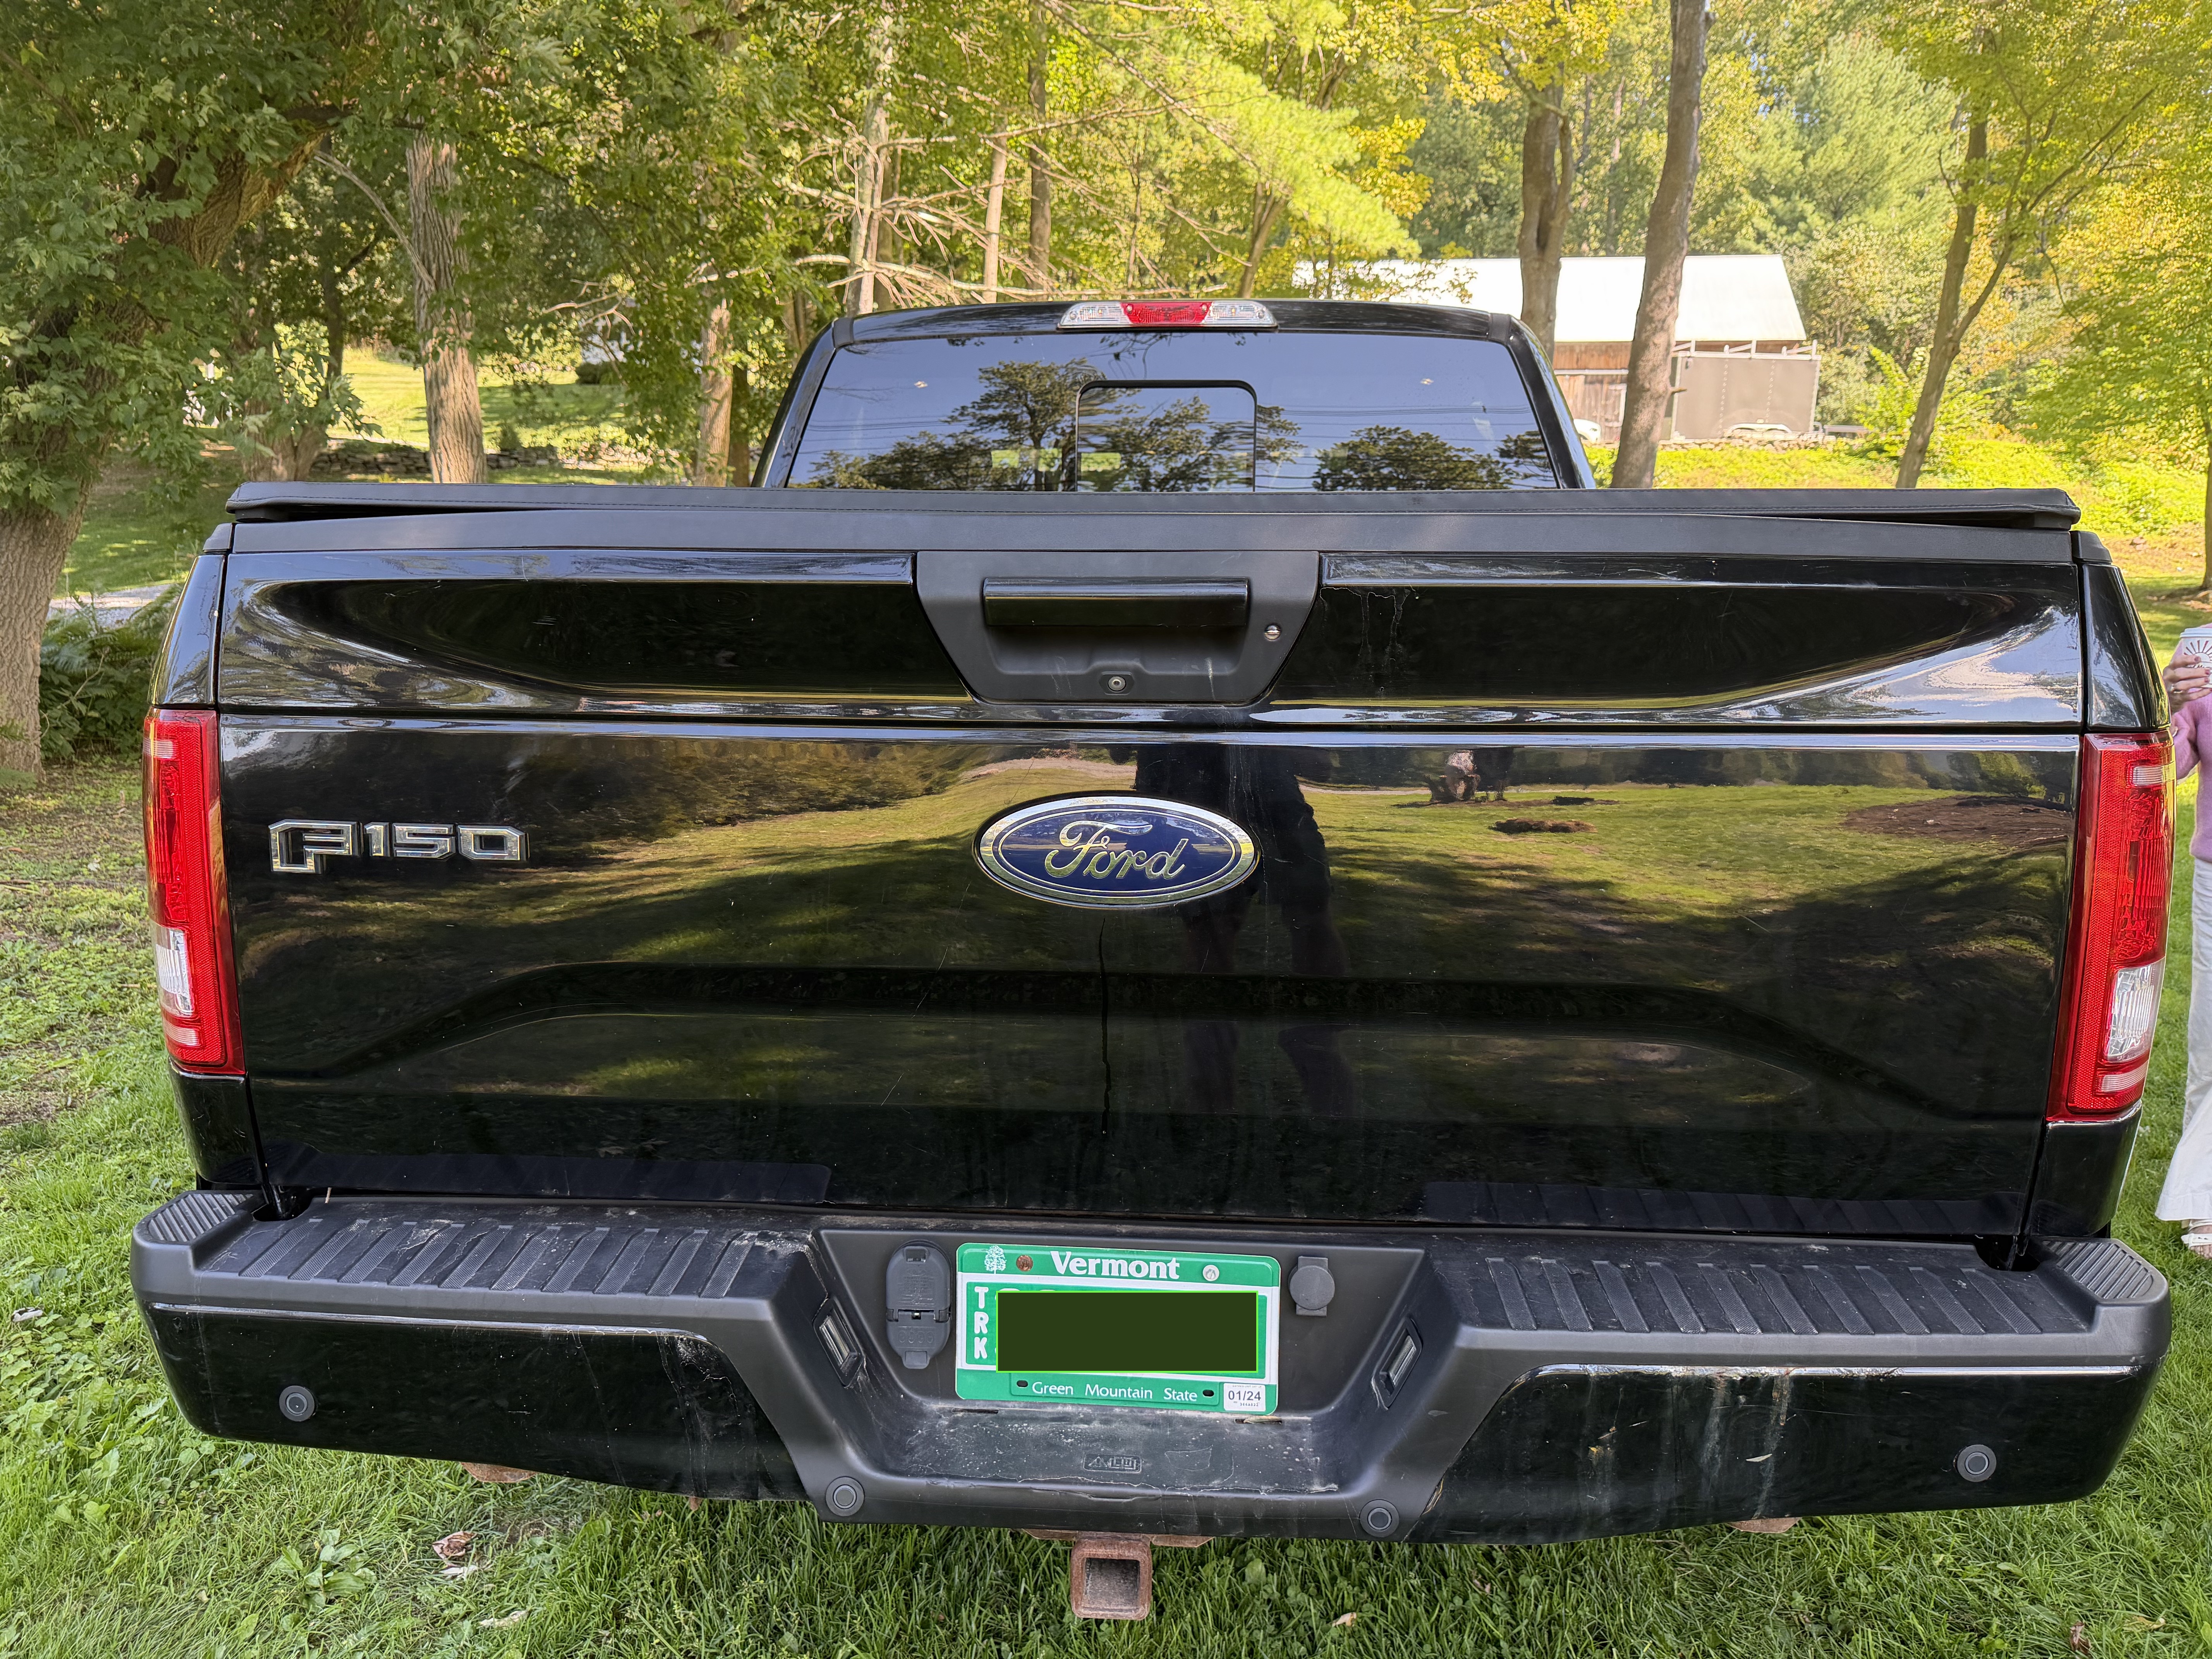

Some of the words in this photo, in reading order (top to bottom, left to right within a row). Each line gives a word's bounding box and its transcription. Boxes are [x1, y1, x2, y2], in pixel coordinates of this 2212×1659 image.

[1044, 820, 1190, 880] Ford
[1050, 1250, 1180, 1279] Vermont
[1032, 1381, 1074, 1395] Green
[1085, 1384, 1153, 1399] Mountain
[1163, 1388, 1198, 1401] State
[1228, 1390, 1261, 1401] 01/24
